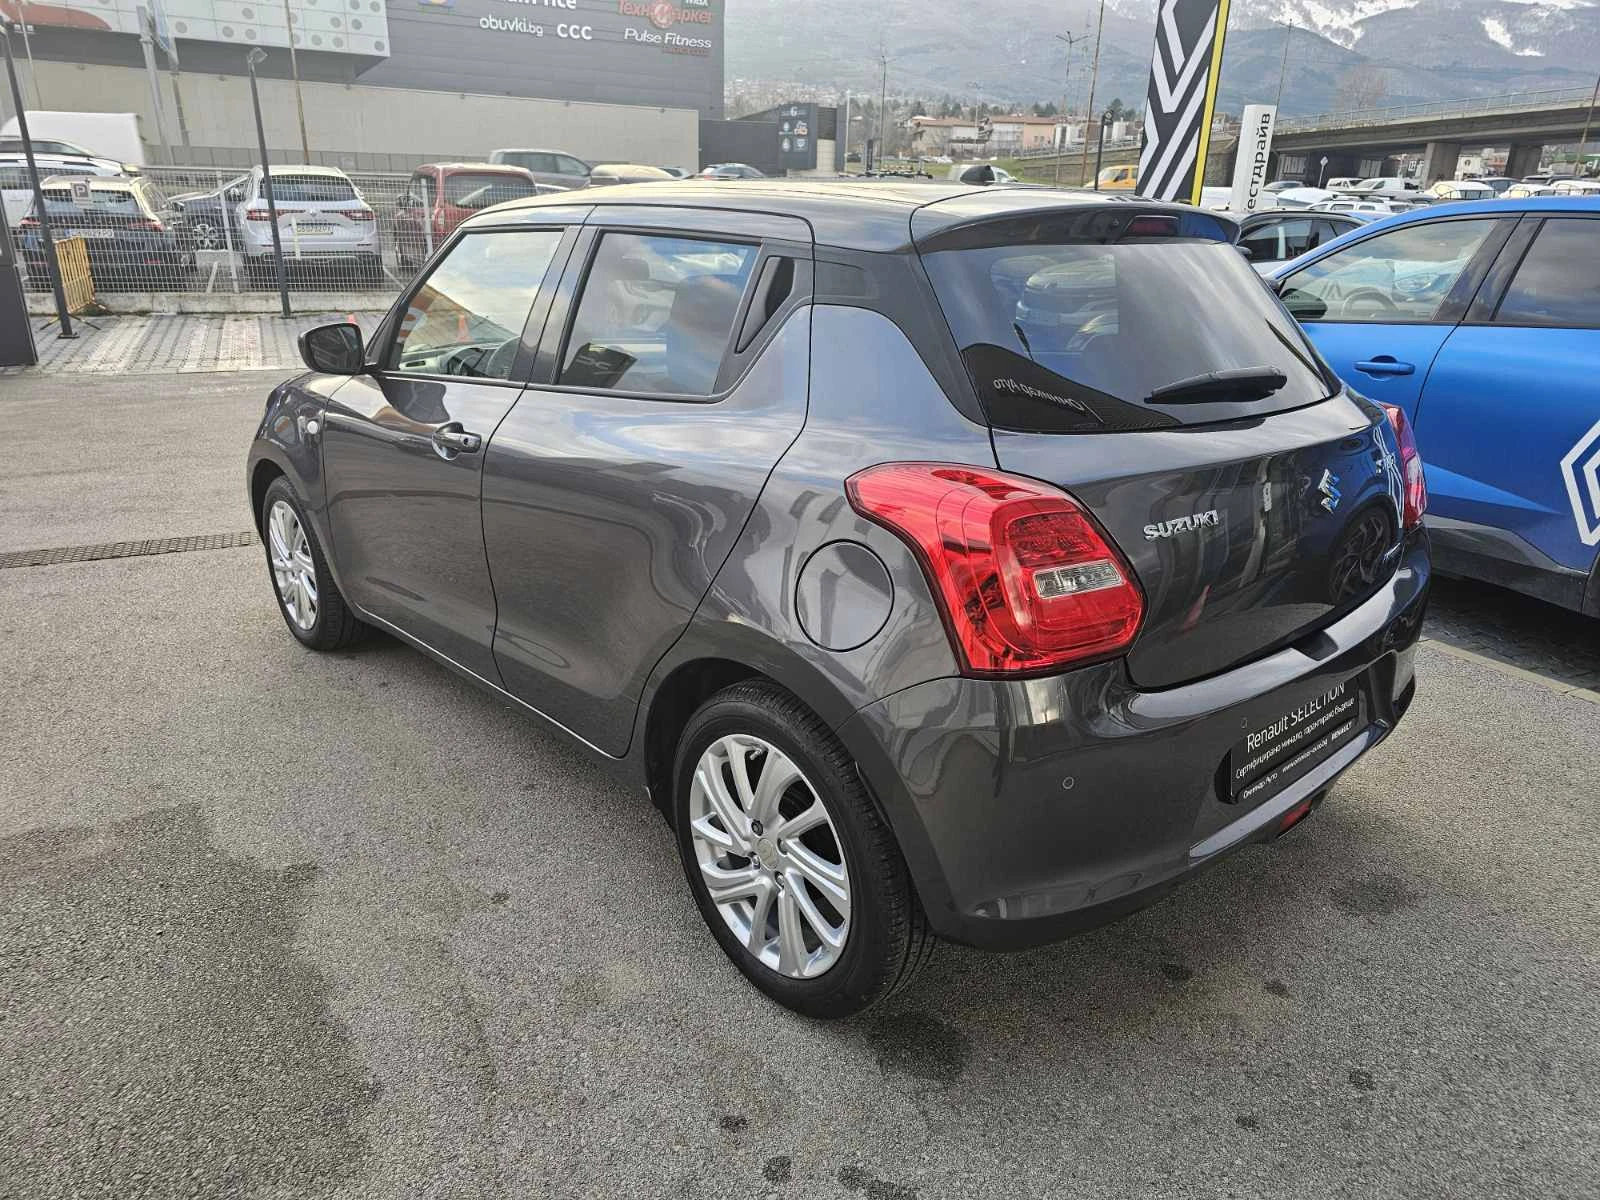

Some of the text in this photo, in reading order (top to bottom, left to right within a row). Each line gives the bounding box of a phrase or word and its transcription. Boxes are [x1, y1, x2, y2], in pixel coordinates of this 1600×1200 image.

[479, 14, 544, 37] obuvki.bg
[624, 28, 712, 48] Pulse Fitness
[1247, 113, 1271, 211] естдрайв
[1143, 509, 1220, 541] SUZUKI
[1246, 682, 1345, 753] Renault SELECTION
